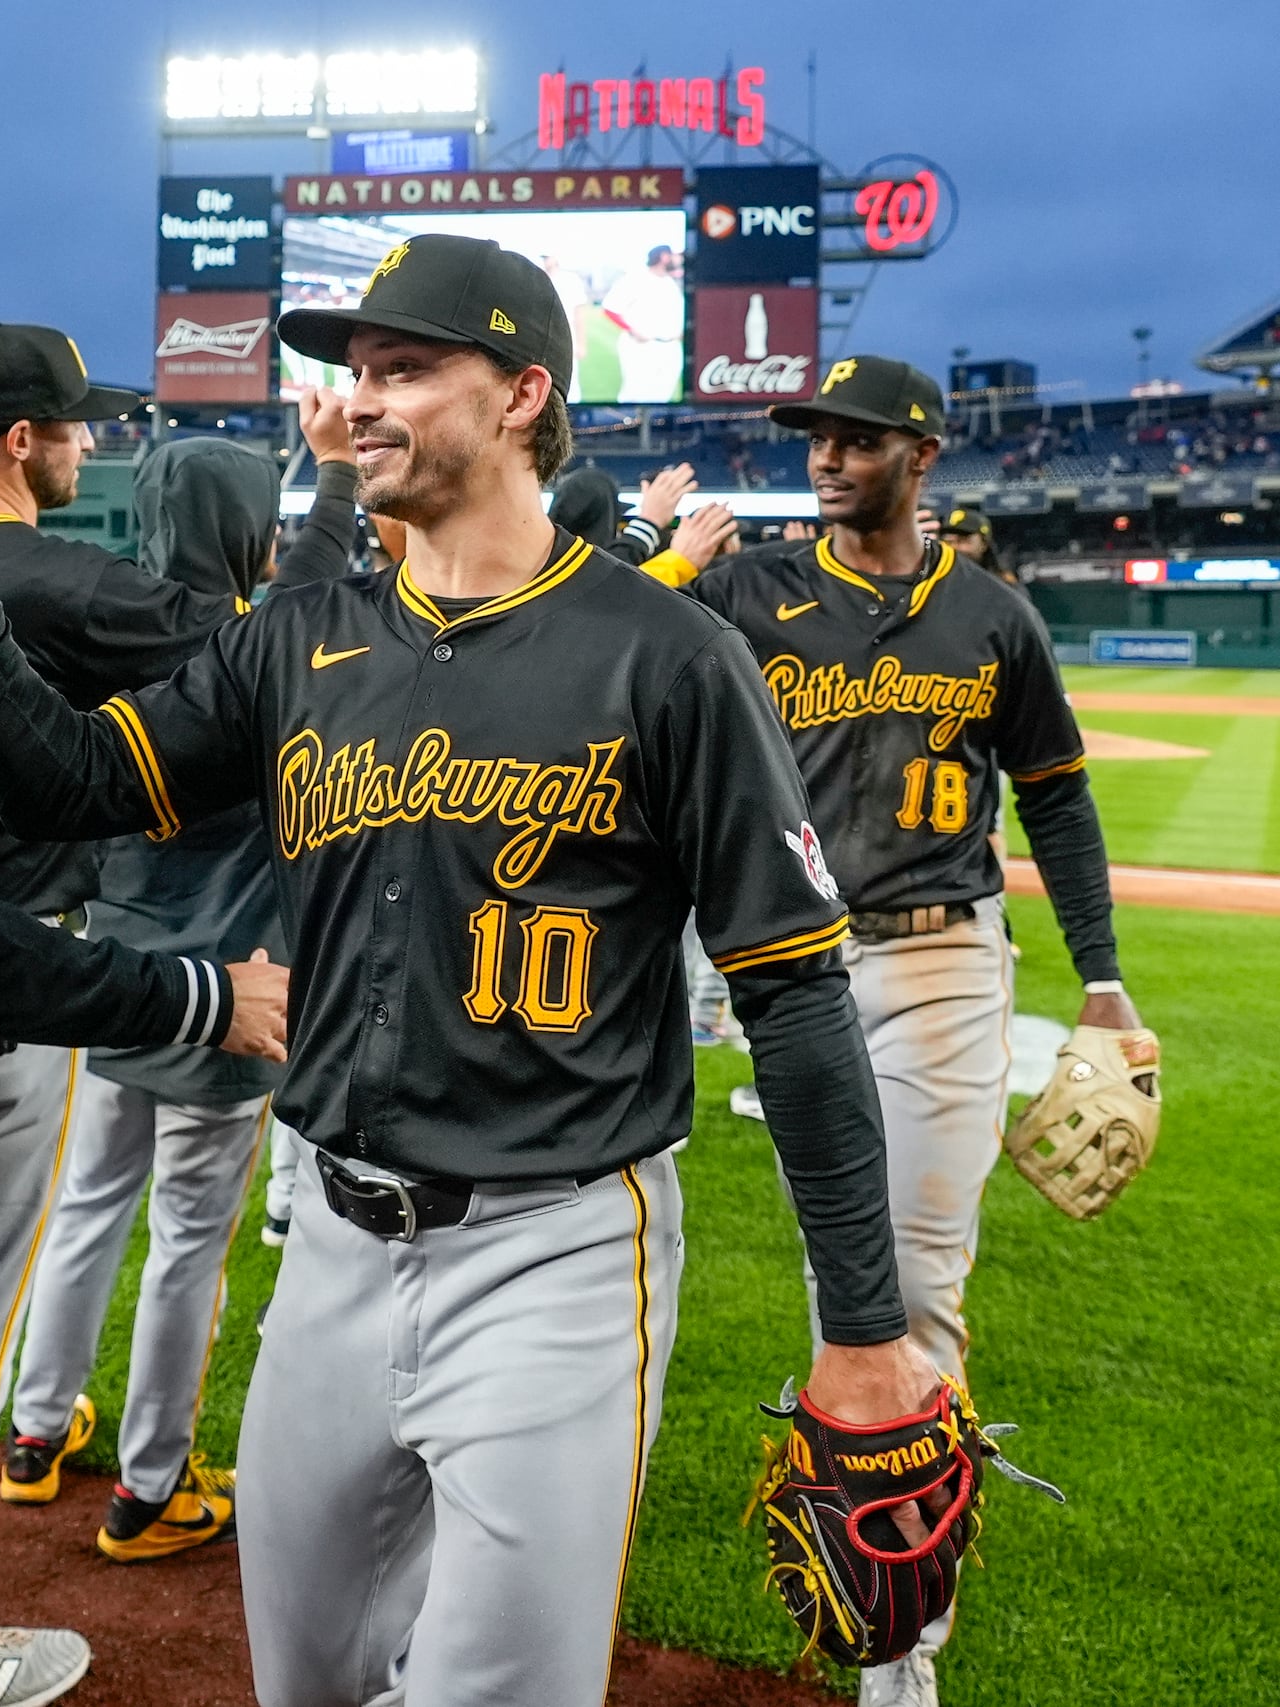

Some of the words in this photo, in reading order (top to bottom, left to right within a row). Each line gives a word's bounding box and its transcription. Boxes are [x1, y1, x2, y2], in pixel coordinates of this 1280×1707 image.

[538, 67, 765, 150] NATIONALS
[197, 188, 234, 214] The
[296, 178, 534, 206] NATIONALS
[554, 175, 662, 200] PARK
[161, 212, 268, 243] Washington
[739, 205, 816, 237] PNC
[192, 243, 236, 271] Post
[821, 358, 858, 395] P
[762, 653, 1000, 752] Pittsburgh
[277, 728, 626, 890] Pittsburgh
[895, 756, 969, 834] 18
[462, 899, 600, 1034] 10
